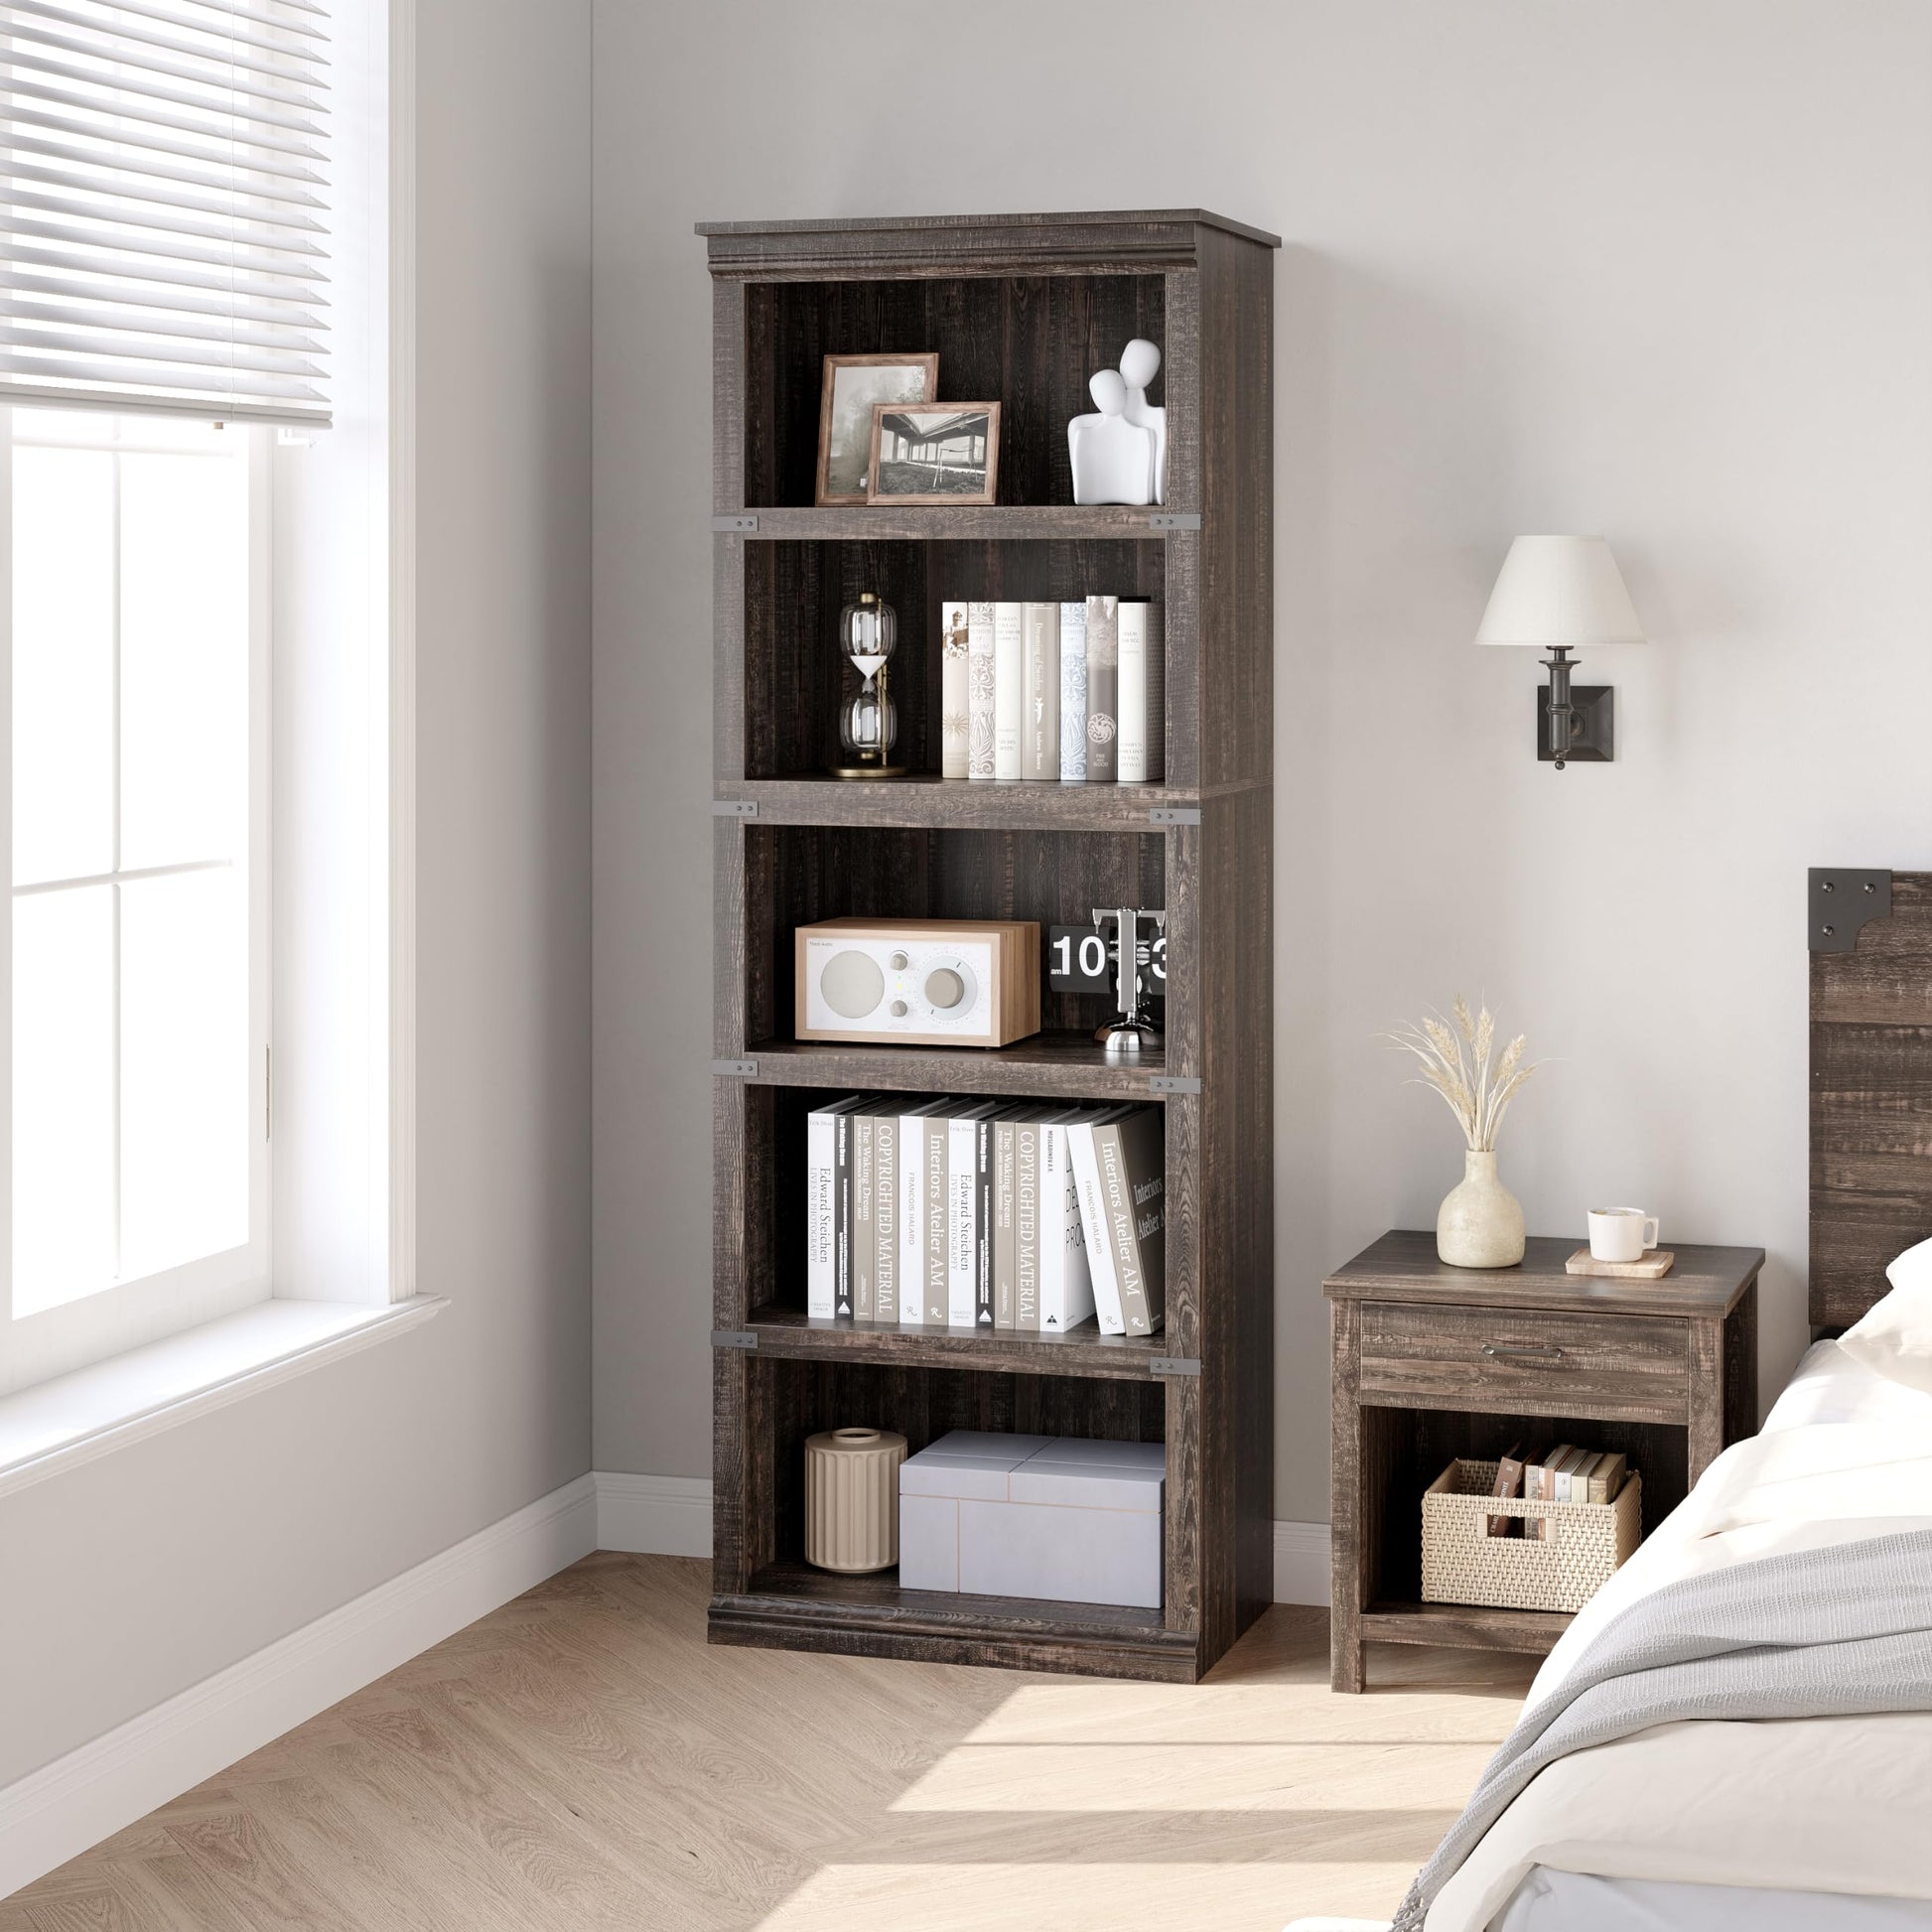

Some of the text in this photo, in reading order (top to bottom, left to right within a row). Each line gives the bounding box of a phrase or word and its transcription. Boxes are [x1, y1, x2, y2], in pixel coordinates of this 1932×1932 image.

[1053, 935, 1106, 977] 10
[819, 1168, 831, 1263] Edward Steichen
[861, 1124, 872, 1220] The Waking Dream
[878, 1125, 893, 1313] COPYRIGHTED MATERIAL
[930, 1134, 944, 1287] Interiors Atelier AM
[1002, 1130, 1012, 1228] The Waking Dream
[1102, 1142, 1140, 1296] Interiors Atelier AM
[1133, 1177, 1164, 1205] Interiors
[960, 1174, 972, 1271] Edward Steichen
[1020, 1131, 1035, 1321] COPYRIGHTED MATERIAL
[1093, 1222, 1102, 1254] HALARD
[1138, 1213, 1160, 1241] Atelier
